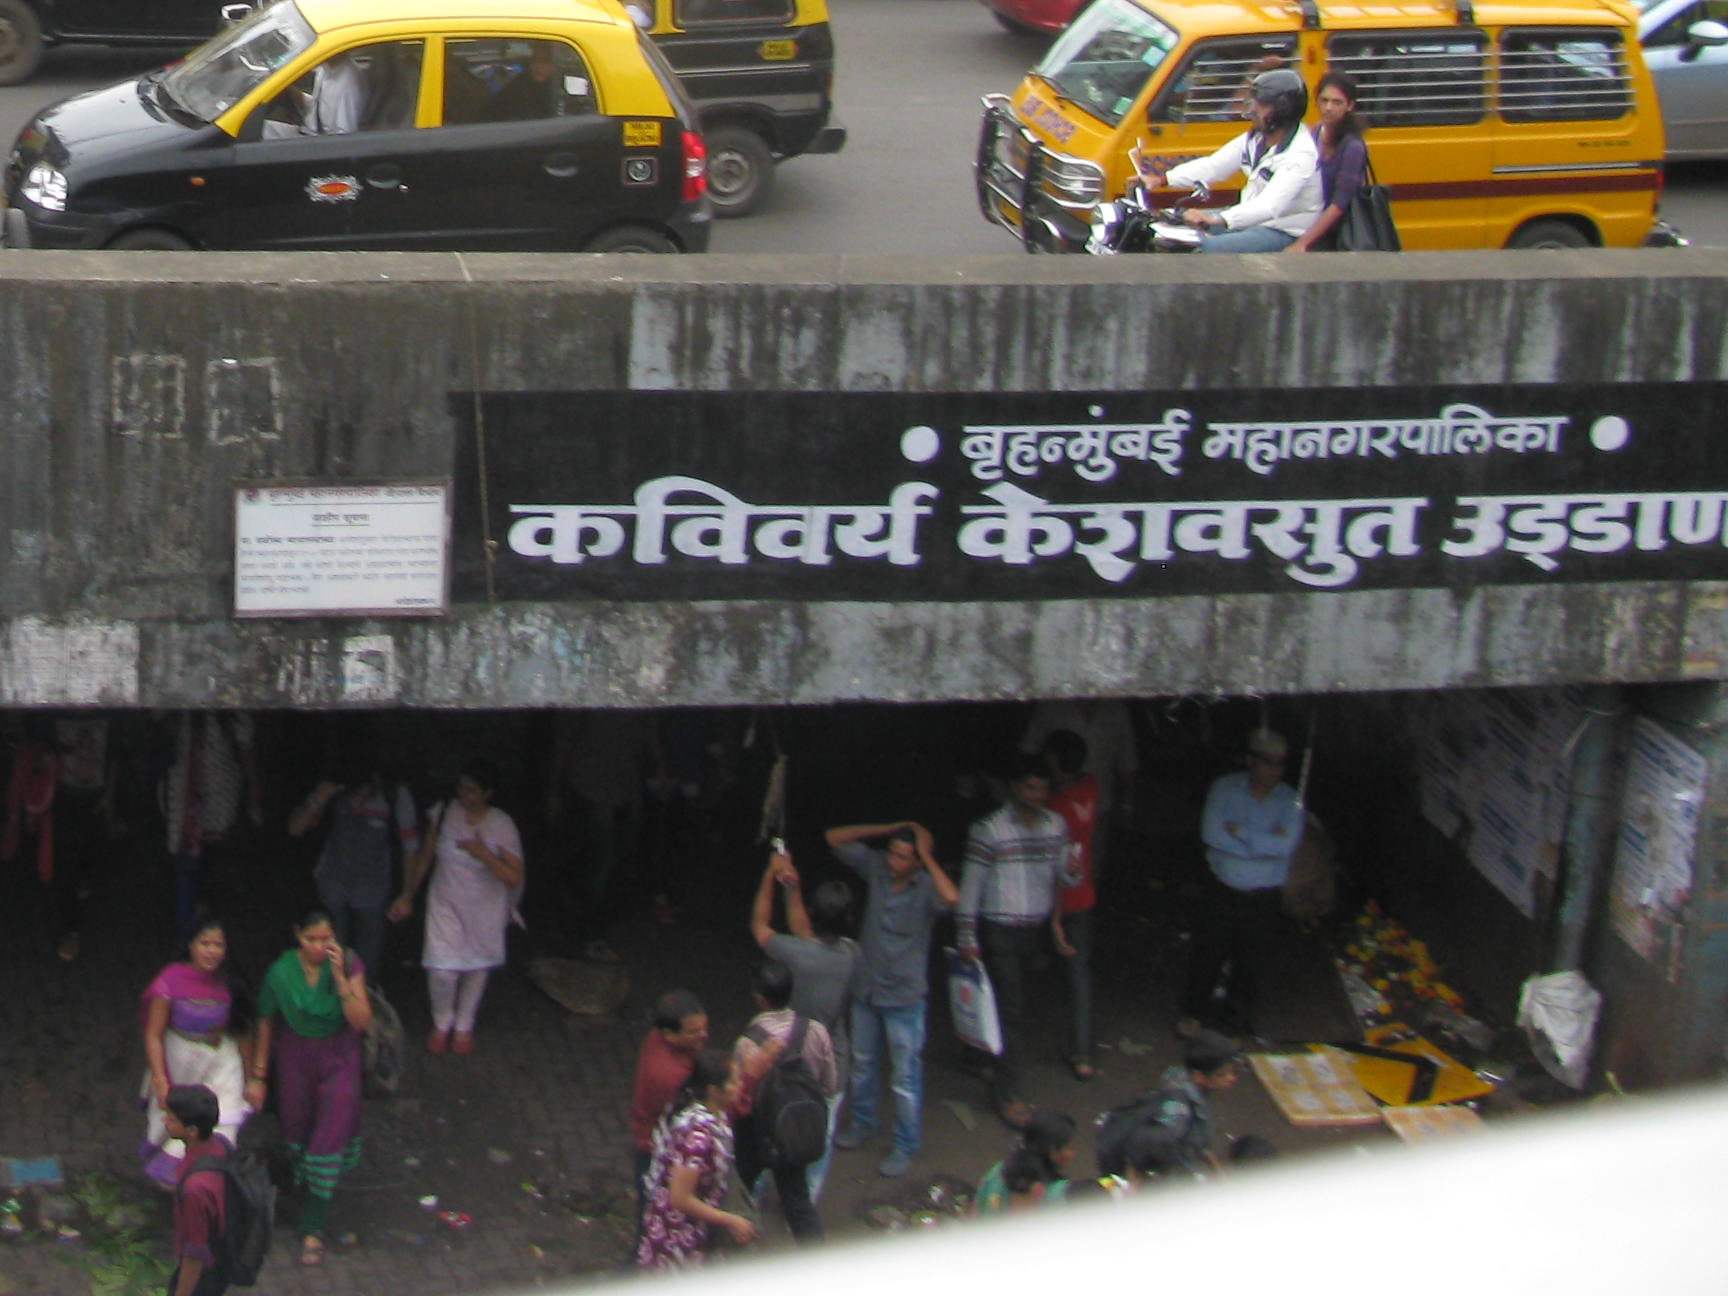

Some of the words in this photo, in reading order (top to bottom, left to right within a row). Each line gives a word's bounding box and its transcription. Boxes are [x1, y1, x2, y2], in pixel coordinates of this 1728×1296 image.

[960, 404, 1192, 482] बृहन्मुंबई
[1202, 403, 1570, 475] महानगरपालिका
[506, 475, 940, 567] कविवर्य
[956, 479, 1432, 589] केशवसुत
